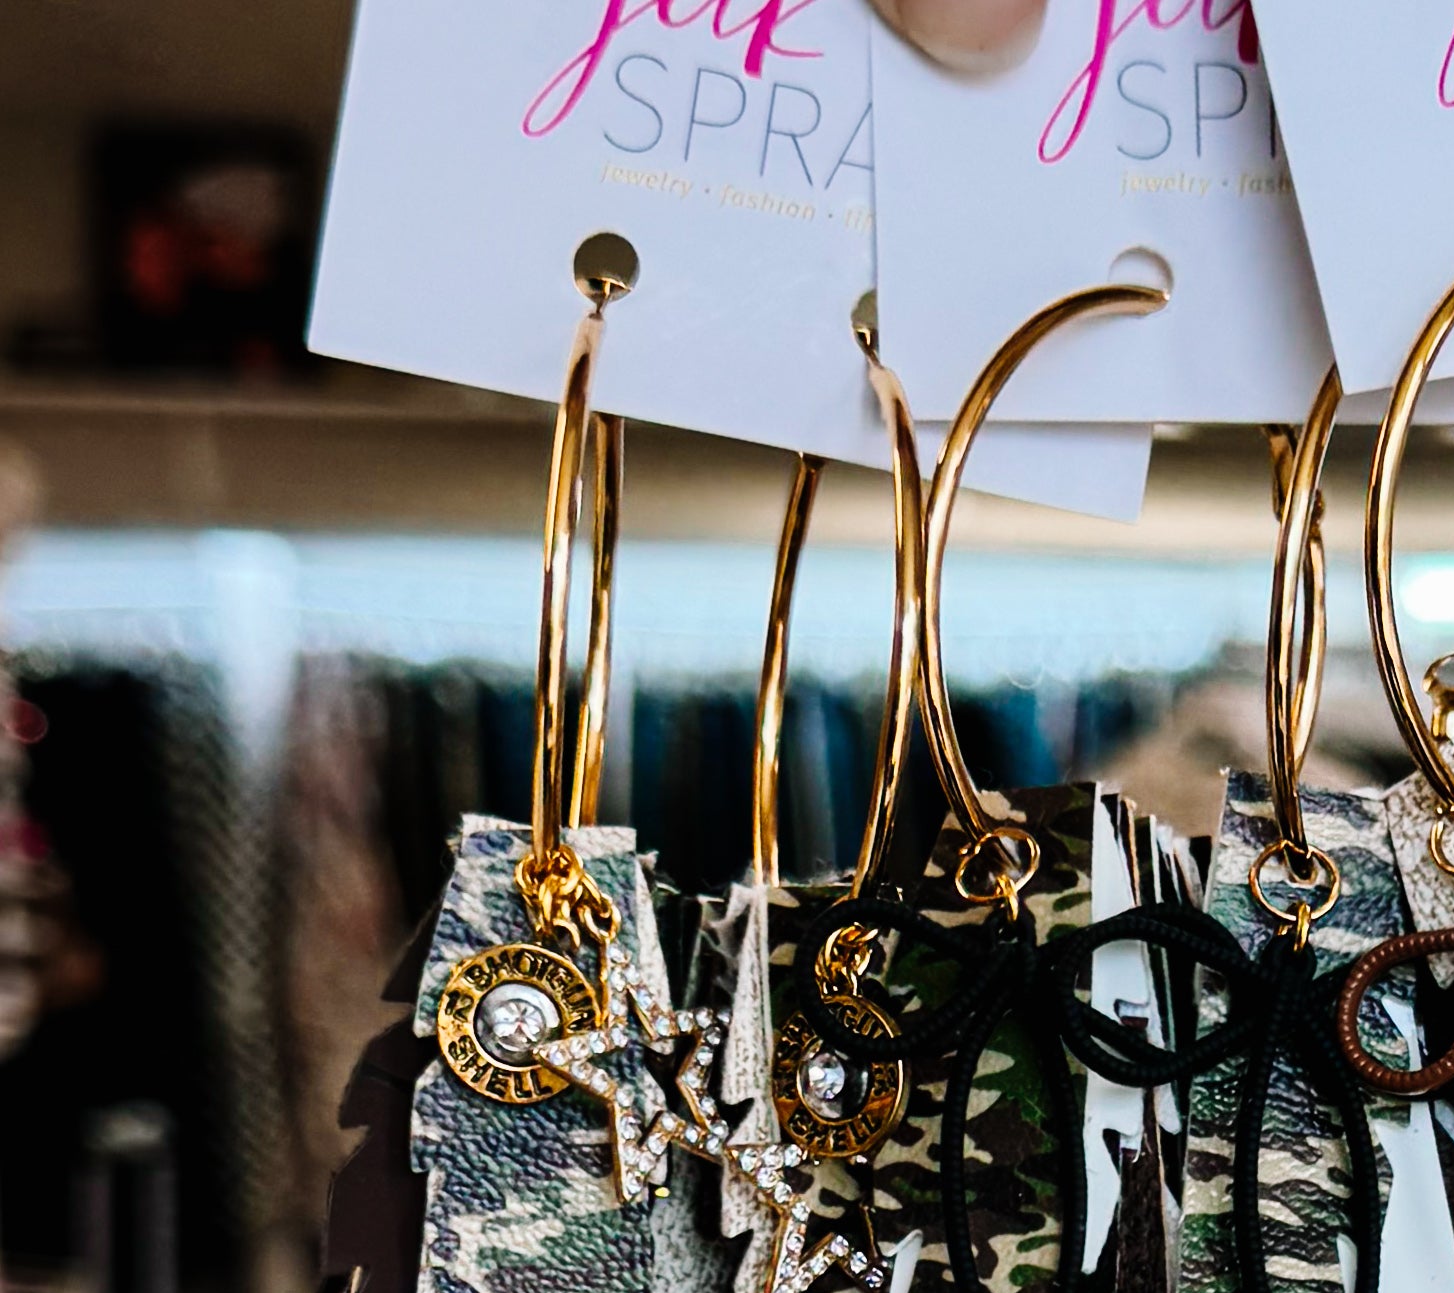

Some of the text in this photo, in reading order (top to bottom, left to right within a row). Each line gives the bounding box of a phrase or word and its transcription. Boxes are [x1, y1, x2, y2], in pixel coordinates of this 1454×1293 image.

[603, 54, 874, 190] SPRA
[601, 160, 695, 200] jewelry
[718, 184, 817, 223] fashion
[1119, 169, 1211, 197] jewelry
[448, 1035, 554, 1098] SHELL
